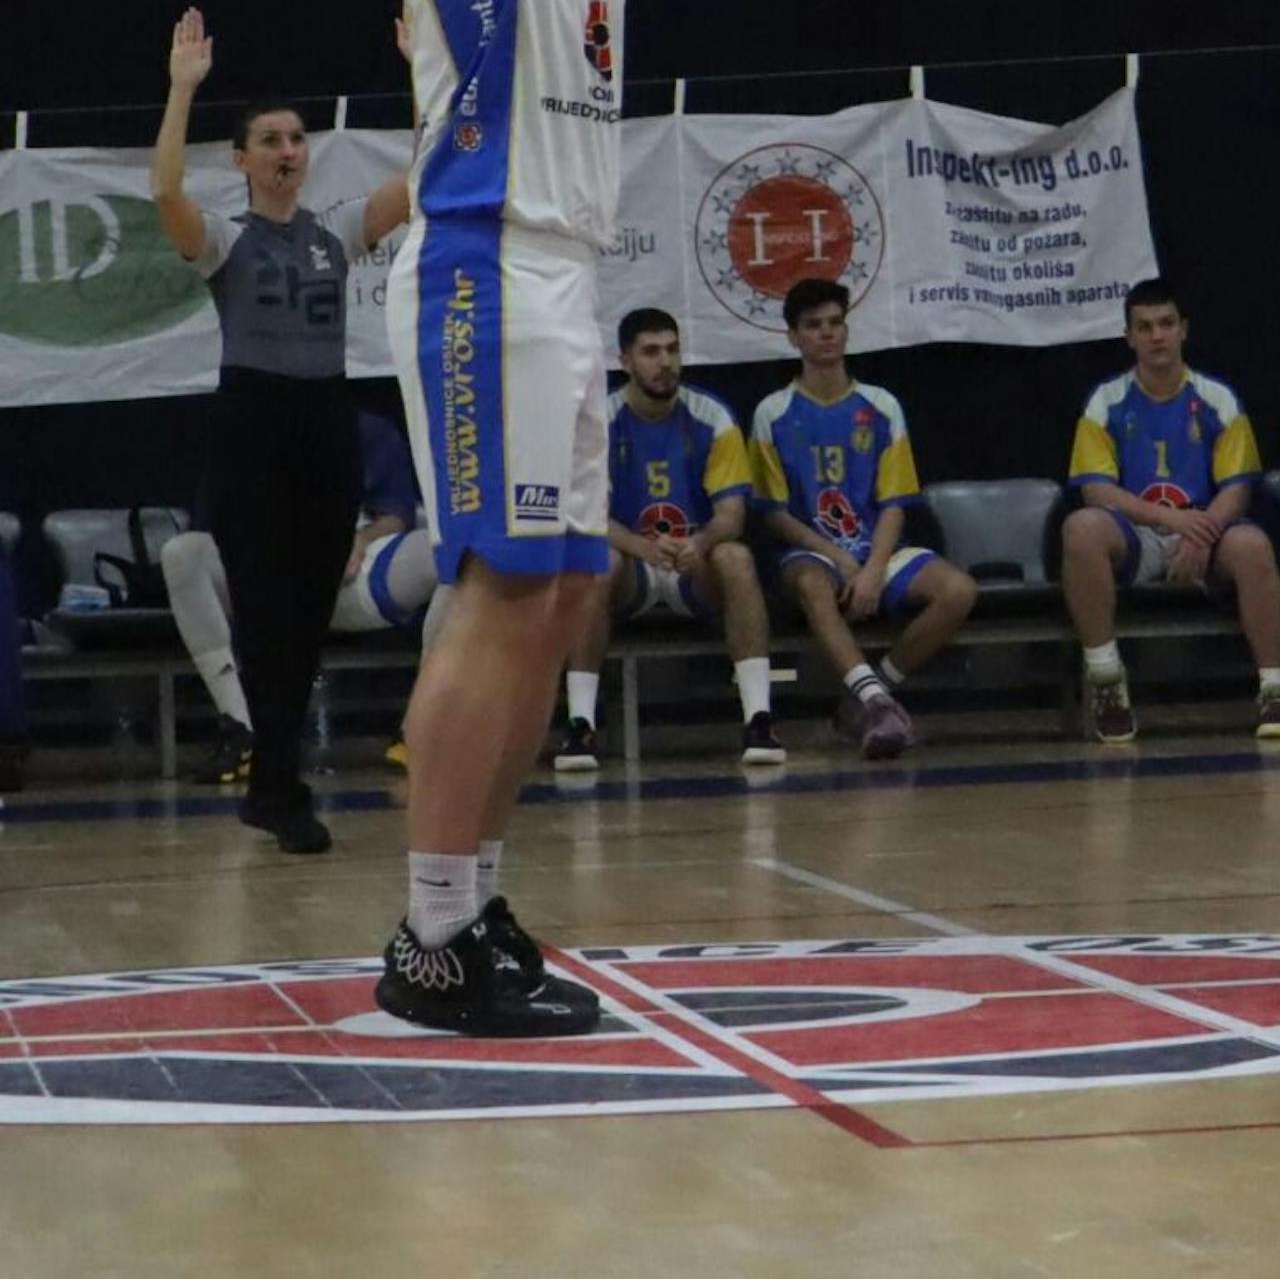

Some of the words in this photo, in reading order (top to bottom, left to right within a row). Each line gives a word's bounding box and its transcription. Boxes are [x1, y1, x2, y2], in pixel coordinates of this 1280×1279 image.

[919, 282, 970, 303] servis
[1066, 280, 1131, 307] aparata
[448, 268, 482, 514] www.vros.hr
[811, 445, 845, 484] 13
[1153, 440, 1171, 478] 1
[646, 460, 671, 498] 5
